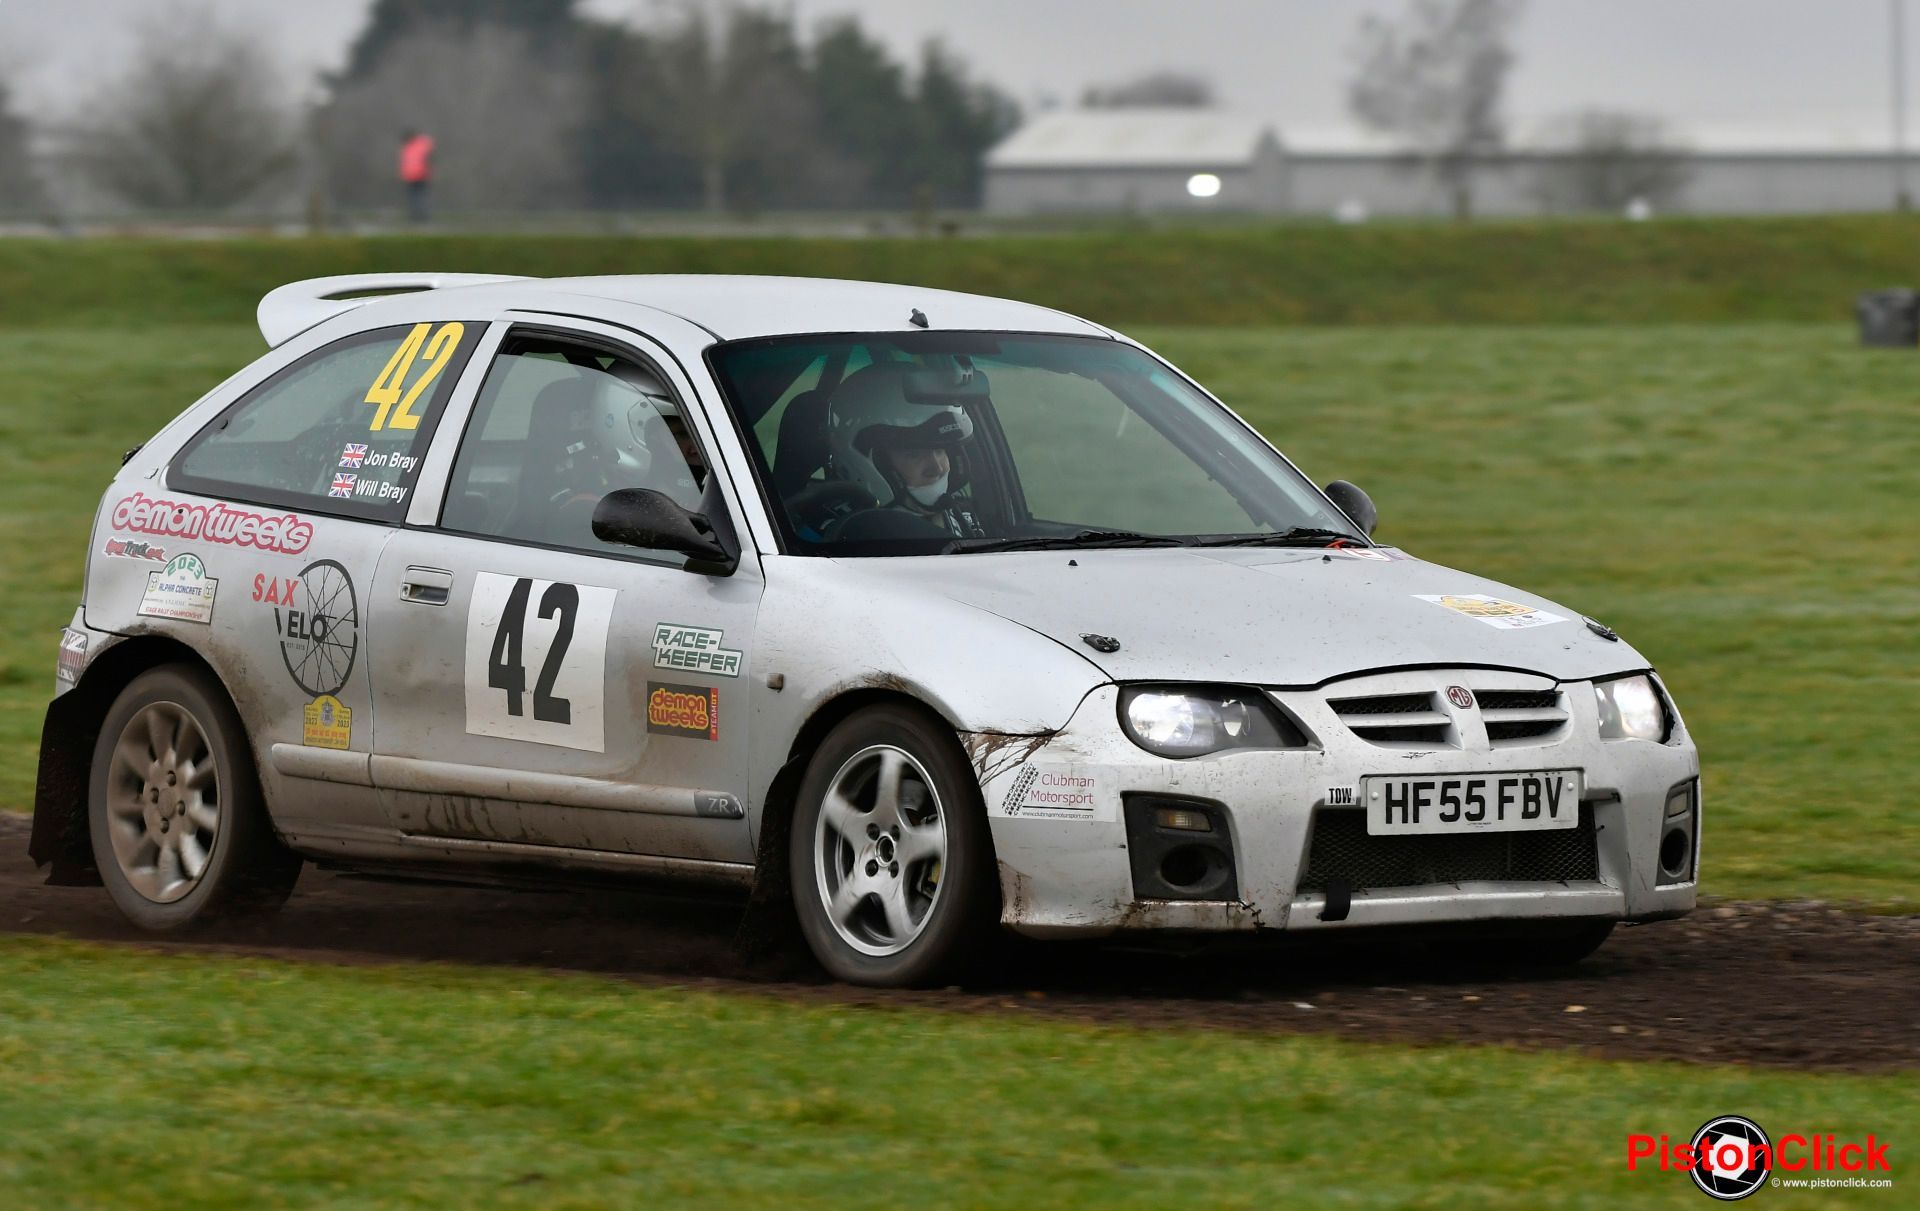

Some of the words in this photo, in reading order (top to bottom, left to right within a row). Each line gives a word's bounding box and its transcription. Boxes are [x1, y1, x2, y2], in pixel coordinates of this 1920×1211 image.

[364, 322, 464, 431] 42
[364, 450, 387, 467] Jon
[389, 452, 418, 472] Bray
[355, 479, 378, 497] Will
[378, 481, 408, 503] Bray
[113, 493, 205, 539] demon
[204, 503, 313, 554] tweeks
[168, 556, 203, 580] 2023
[252, 573, 299, 608] SAX
[656, 629, 717, 649] RACE-
[488, 577, 579, 725] 42
[657, 647, 738, 672] KEEPER
[652, 689, 705, 712] demon
[1449, 687, 1471, 706] MG
[650, 704, 708, 727] tweeks
[1041, 774, 1094, 787] Clubman
[708, 798, 730, 813] ZR
[1031, 790, 1093, 805] Motorsport
[1329, 787, 1352, 804] TOW
[1385, 780, 1485, 824] HF55
[1498, 777, 1563, 820] FBV
